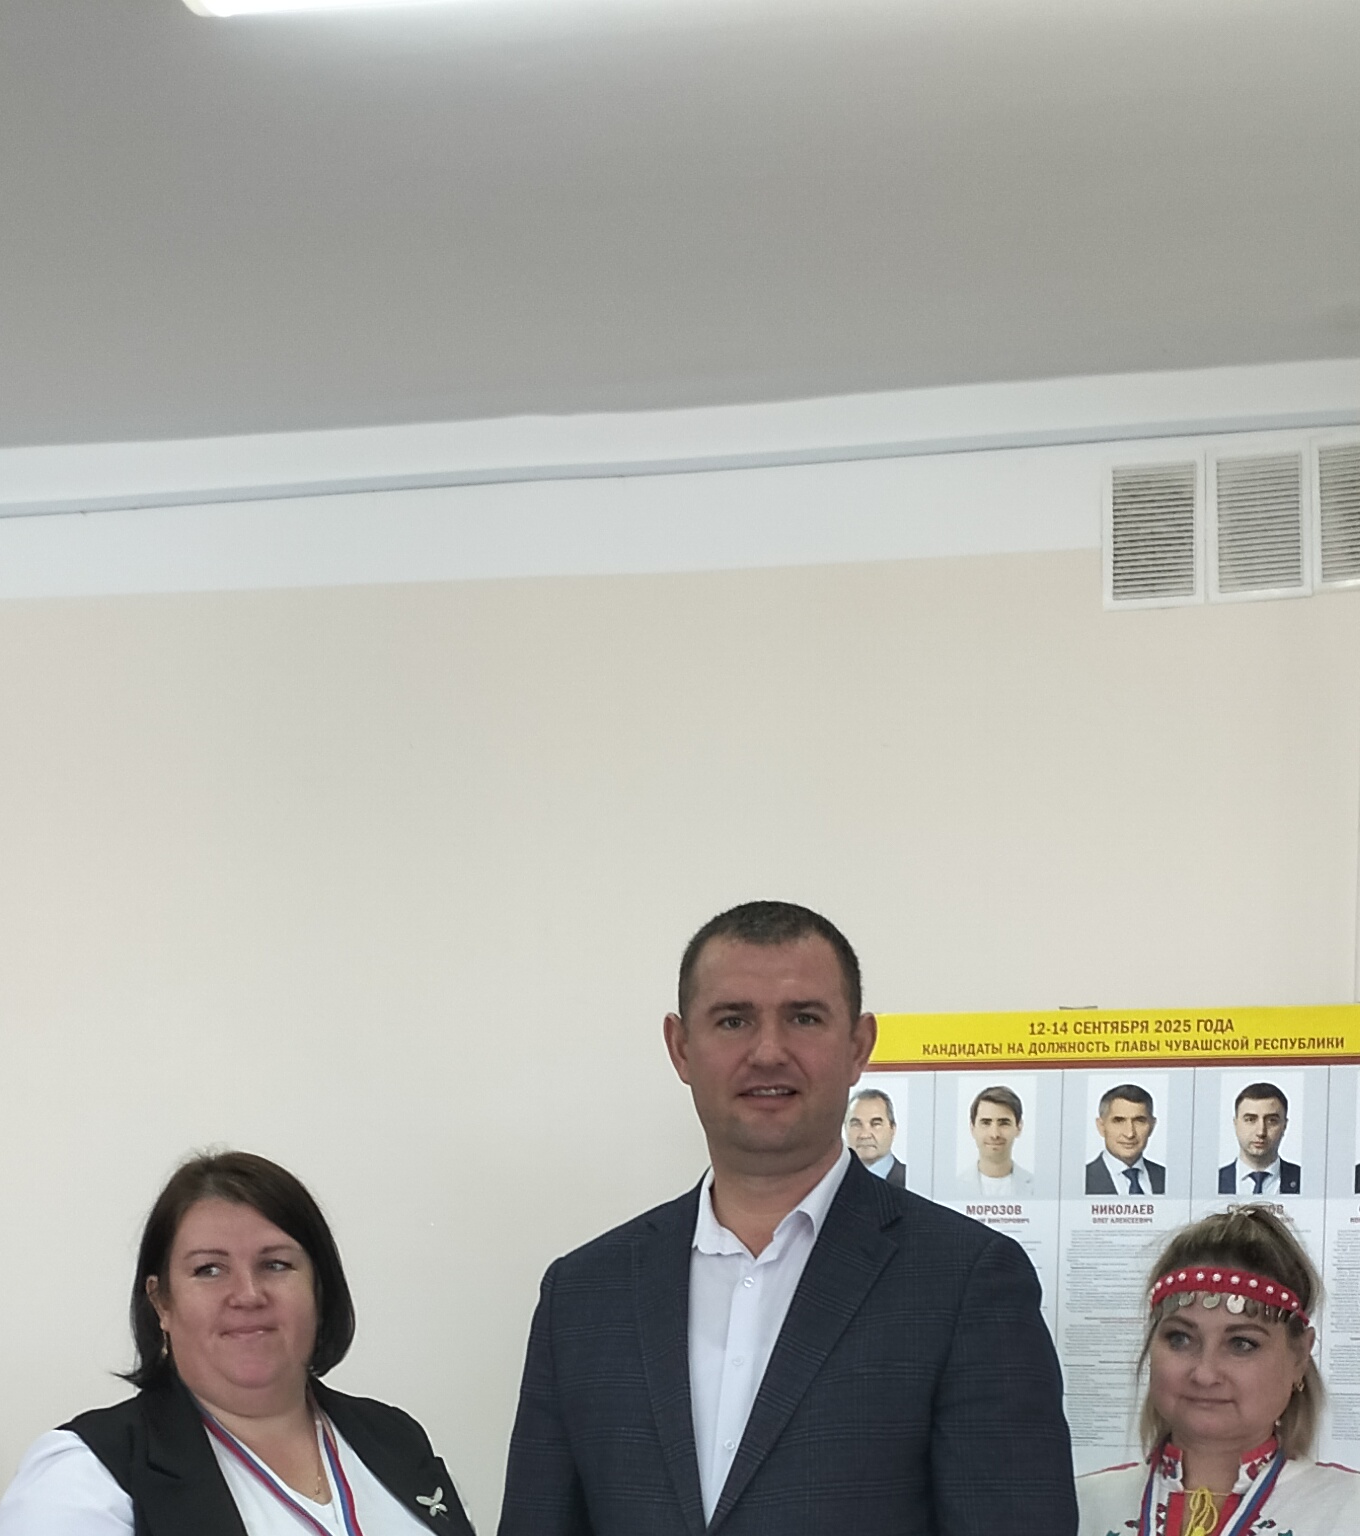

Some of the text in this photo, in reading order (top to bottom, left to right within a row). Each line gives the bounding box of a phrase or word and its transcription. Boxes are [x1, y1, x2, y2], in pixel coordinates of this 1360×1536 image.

[1029, 1018, 1234, 1036] 12-14 СЕНТЯБРЯ 2025 ГОДА
[922, 1036, 1345, 1057] КАНДИДАТЫ НА ДОЛЖНОСТЬ ГЛАВЫ ЧУВАШСКОЙ РЕСПУБЛИКИ
[966, 1204, 1022, 1216] МОРОЗОВ
[1091, 1204, 1154, 1216] НИКОЛАЕВ
